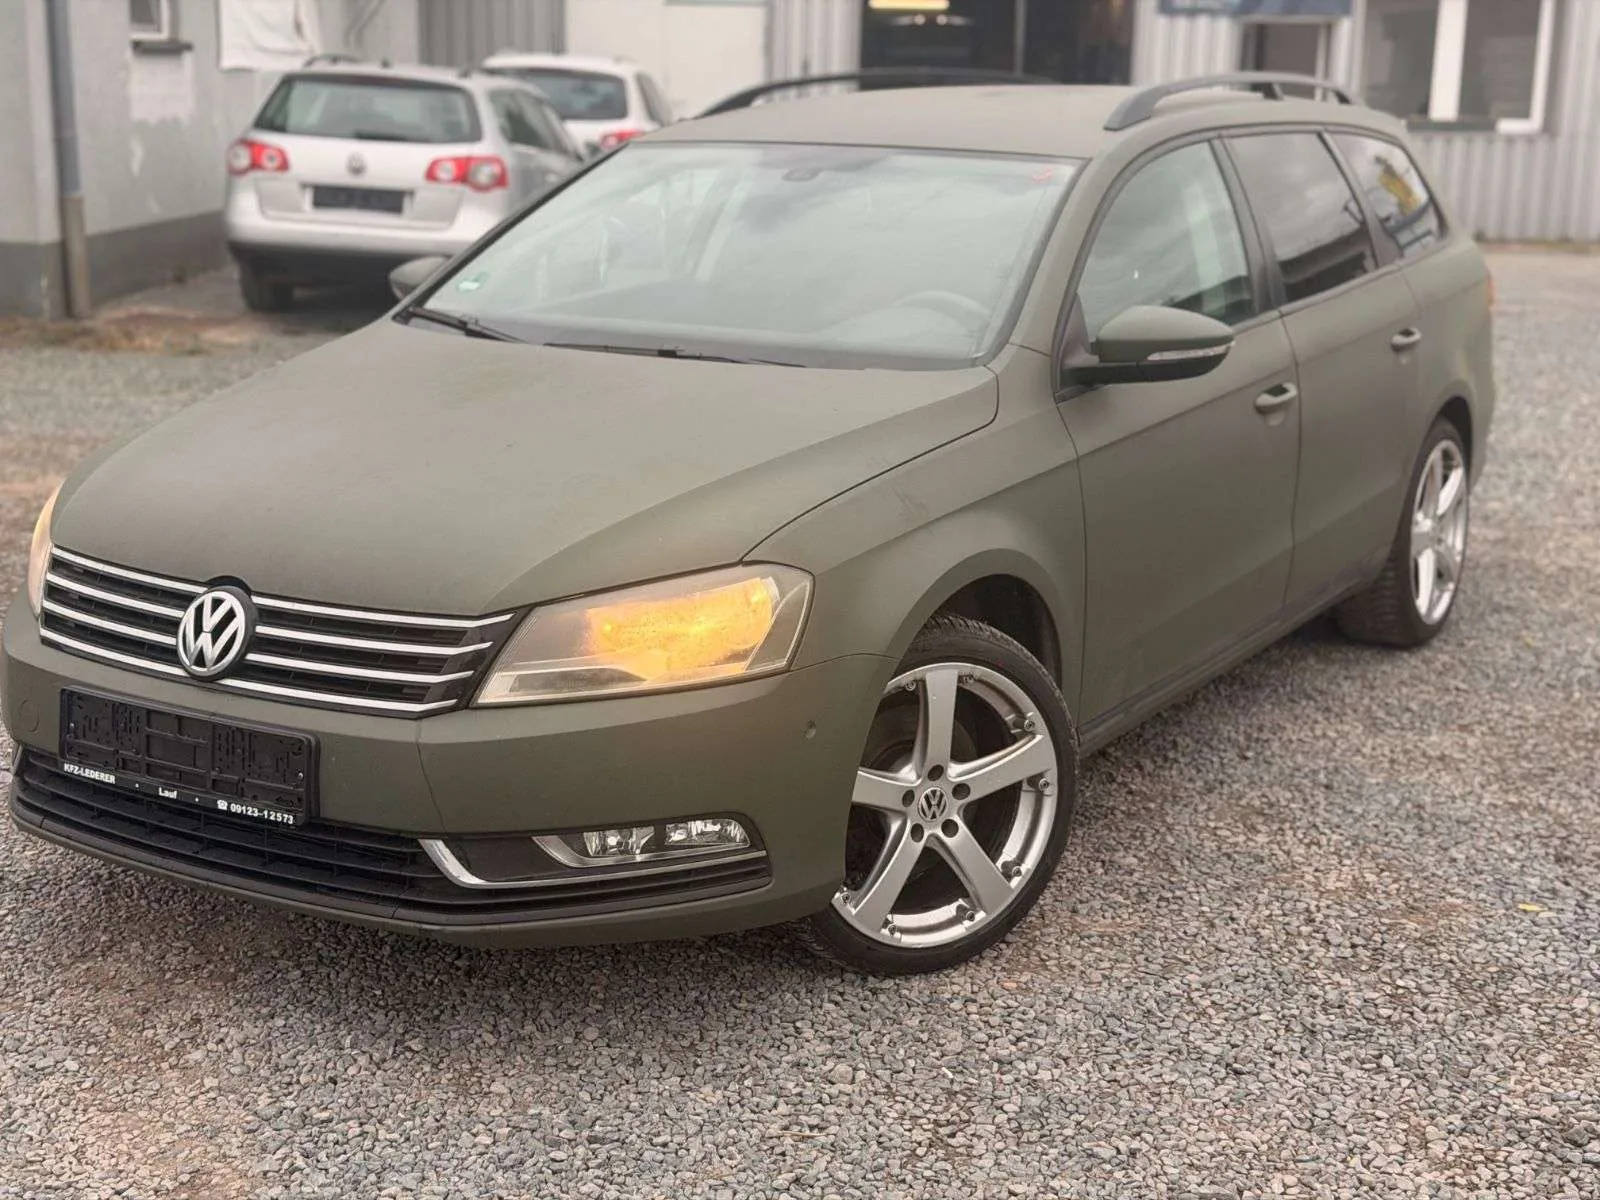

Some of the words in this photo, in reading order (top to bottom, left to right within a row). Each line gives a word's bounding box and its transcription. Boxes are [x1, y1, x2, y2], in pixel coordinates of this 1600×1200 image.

[179, 591, 245, 673] VW
[63, 762, 116, 785] KFZ-LEDERER
[158, 787, 178, 799] Lauf
[230, 803, 294, 825] 09123-12573
[919, 787, 948, 822] VW
